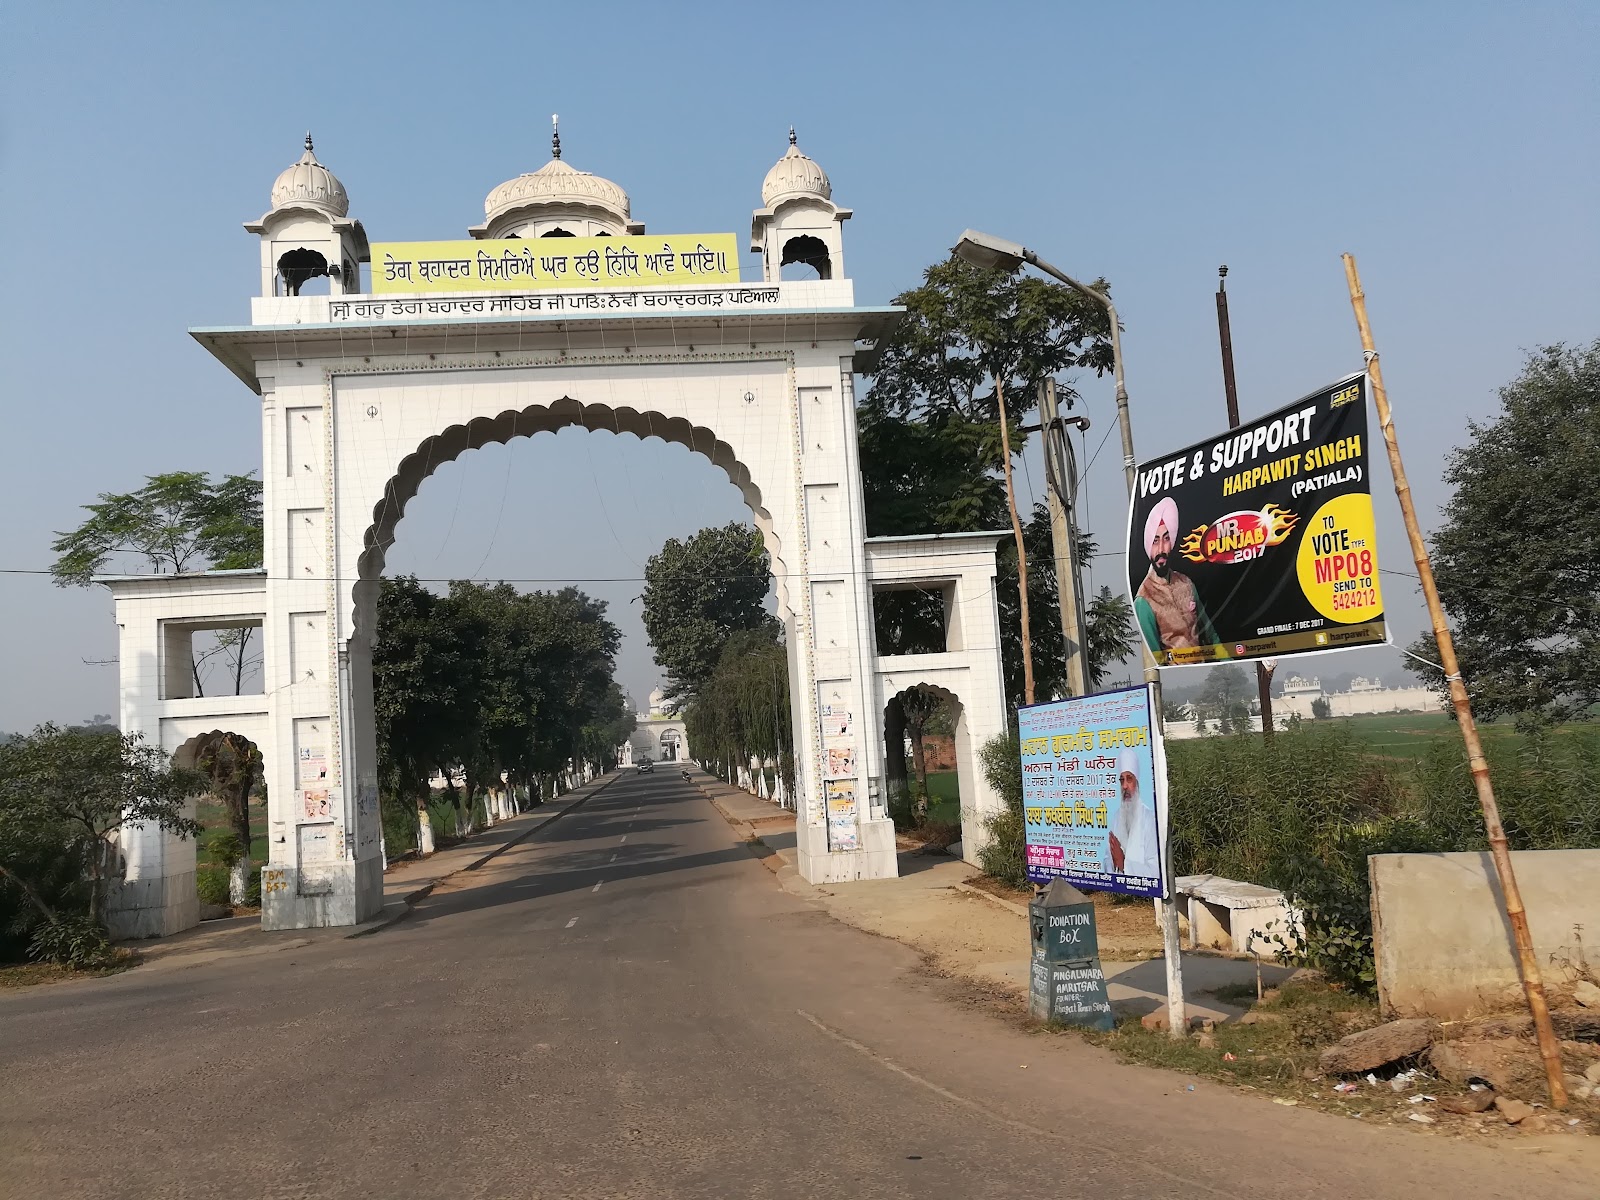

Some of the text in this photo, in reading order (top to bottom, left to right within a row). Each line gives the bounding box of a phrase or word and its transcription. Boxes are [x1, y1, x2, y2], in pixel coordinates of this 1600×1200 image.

[384, 253, 414, 283] ਤੇਗ
[418, 259, 472, 283] ਬਹਾਦਰ
[477, 247, 537, 281] ਸਿਮਰਿਐ
[540, 256, 568, 279] ਘਰ
[574, 249, 600, 281] ਨਉ
[605, 245, 641, 277] ਨਿਧਿ
[644, 243, 675, 276] ਆਵੈ
[355, 302, 387, 320] ਗੁਰੂ
[391, 300, 423, 315] ਤੇਗ
[427, 299, 485, 315] ਬਹਾਦੁਰ
[489, 295, 544, 312] ਸਾਹਿਬ
[547, 294, 564, 310] ਜੀ
[1139, 406, 1317, 498] VOTE & SUPPORT
[1223, 435, 1361, 497] HARPAWIT SINGH
[1291, 465, 1362, 499] (PATIALA)
[1323, 515, 1334, 530] TO
[1312, 529, 1365, 556] VOTE TYPE
[1234, 544, 1266, 563] 2017
[1334, 577, 1372, 592] SEND TO
[1333, 589, 1375, 610] 5424212
[1257, 626, 1274, 635] GRAND
[1300, 621, 1310, 629] DEC
[1311, 619, 1324, 627] 2017
[1329, 628, 1370, 642] harpawit
[1245, 641, 1276, 653] harpawit
[1021, 725, 1148, 758] ਮਹਾਨ ਗੁਰਮਤਿ ਸਮਾਗਮ
[1024, 755, 1116, 773] ਅਨਾਜ ਮੰਡੀ ਘਨੌਰ
[1057, 776, 1064, 787] 16
[1087, 774, 1103, 786] 2017
[1074, 800, 1094, 828] ਸਿੰਘ
[1095, 800, 1107, 828] ਜੀ
[1049, 914, 1090, 928] DONATION
[1053, 969, 1104, 981] PINGALWARA
[1056, 981, 1099, 993] AMRITSAR
[1092, 1002, 1111, 1013] Singh
